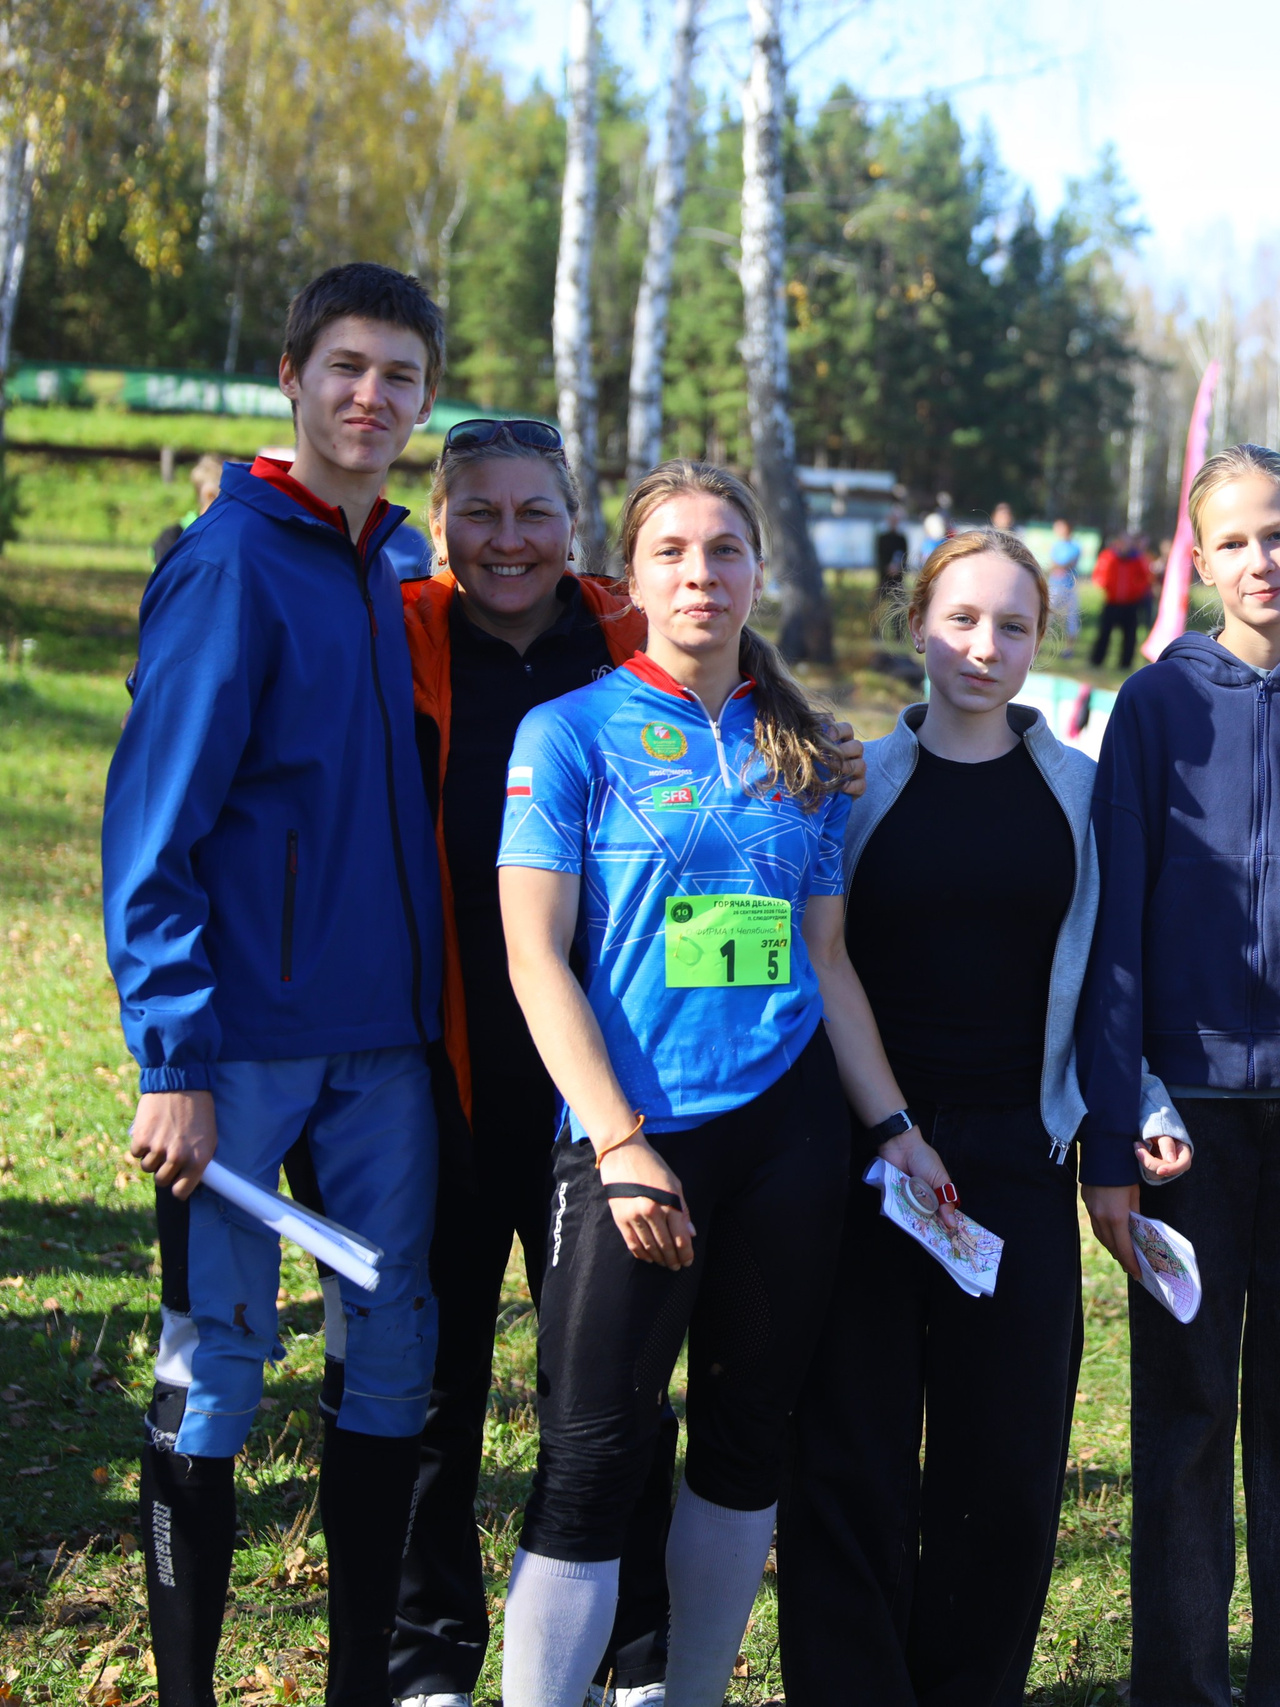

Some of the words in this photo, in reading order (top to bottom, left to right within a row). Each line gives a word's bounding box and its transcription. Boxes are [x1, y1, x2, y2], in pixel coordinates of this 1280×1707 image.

[661, 790, 689, 802] SFR
[713, 900, 751, 908] ГОРЯЧАЯ
[761, 939, 787, 948] ЭТАП
[720, 939, 735, 982] 1
[767, 950, 778, 980] 5
